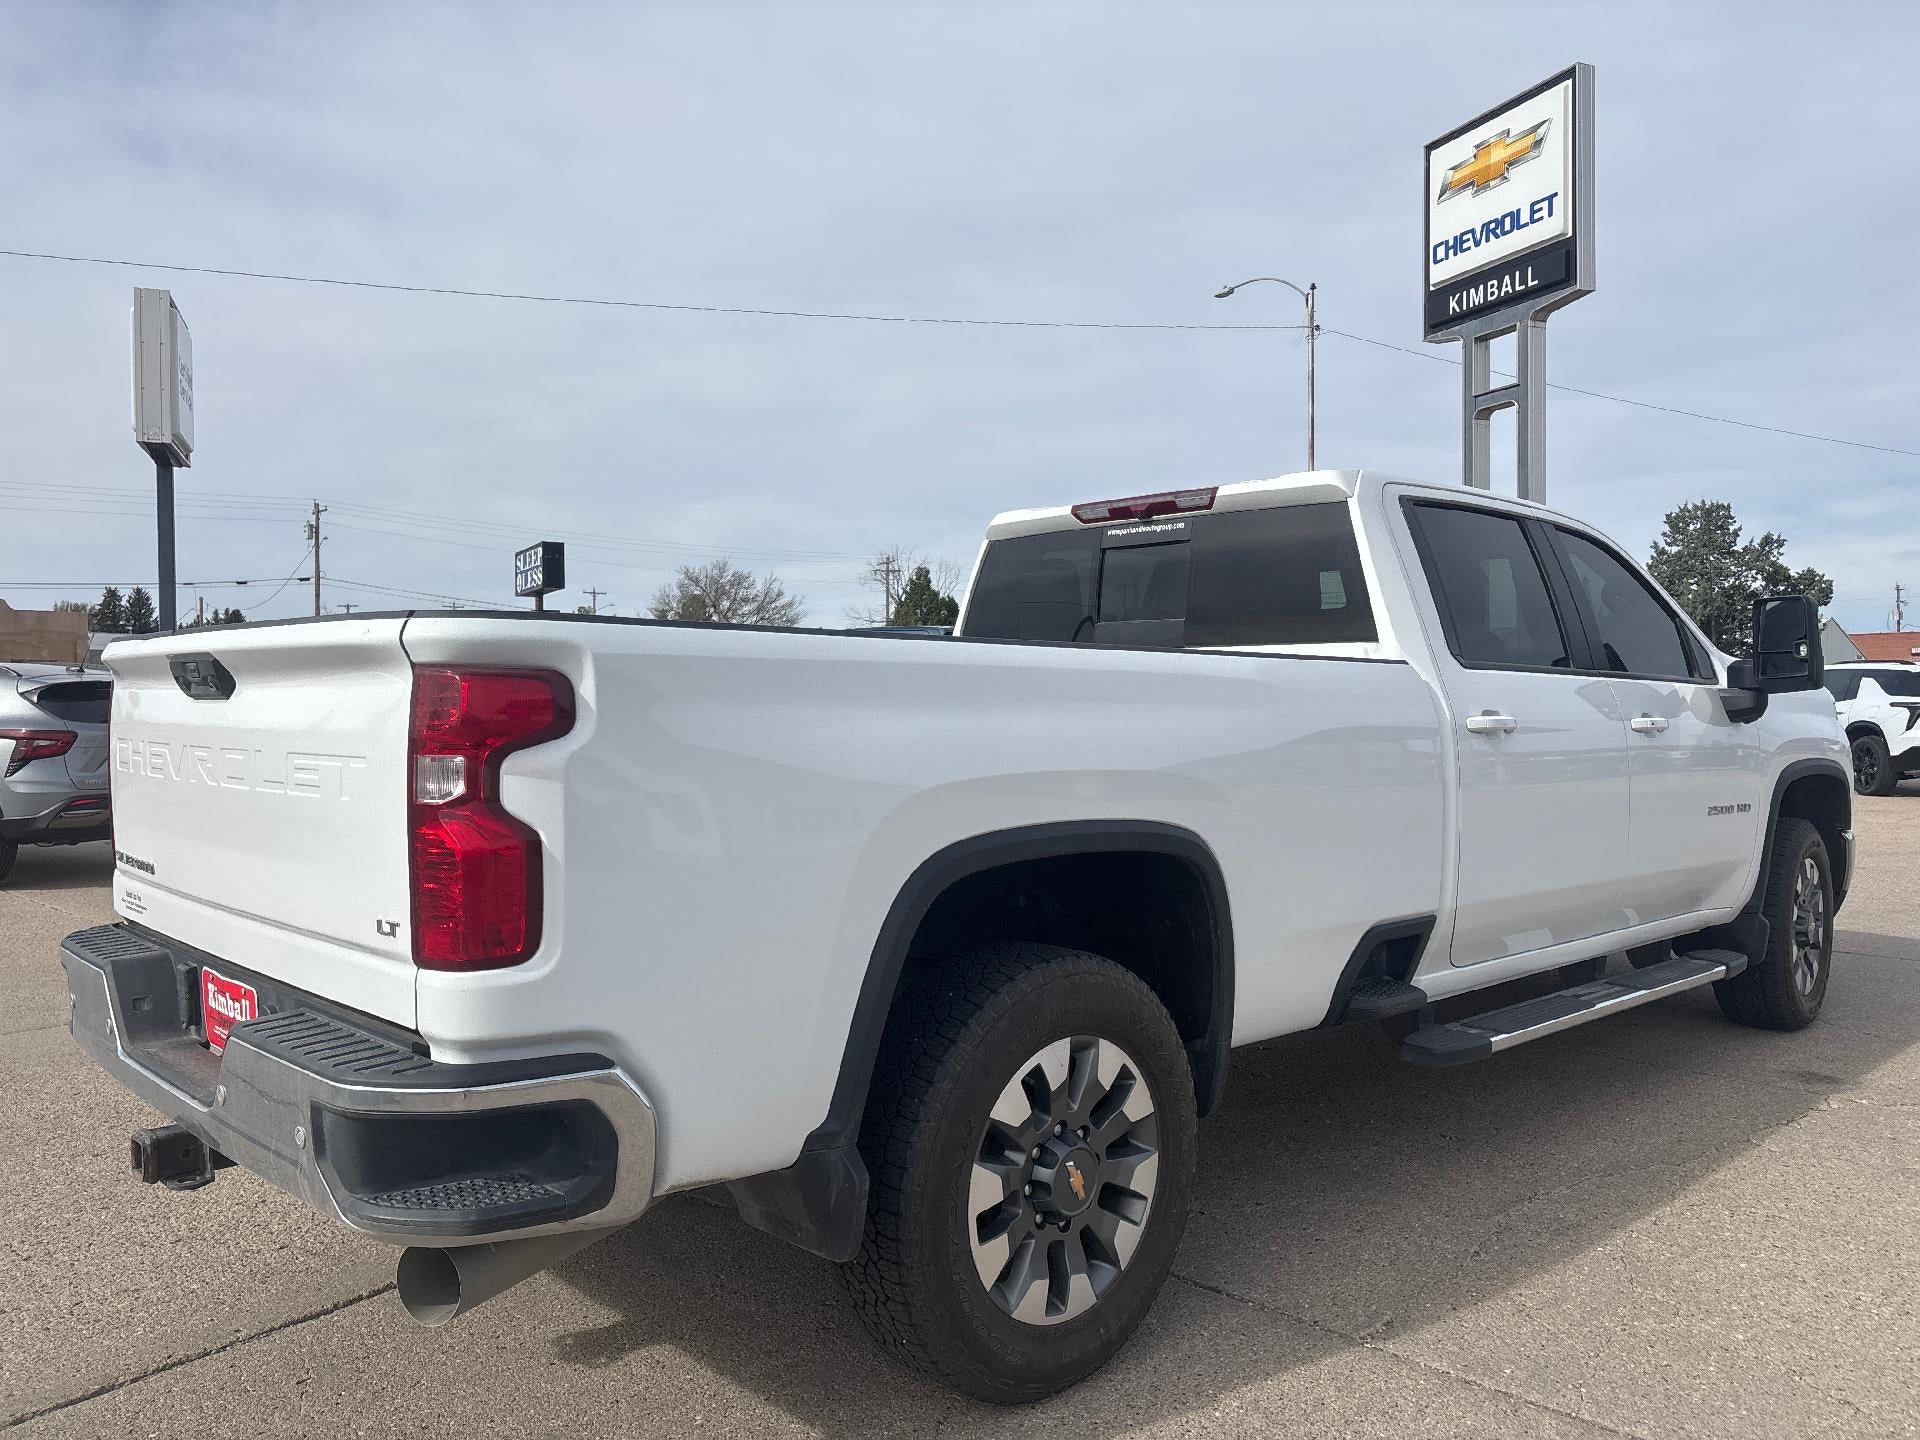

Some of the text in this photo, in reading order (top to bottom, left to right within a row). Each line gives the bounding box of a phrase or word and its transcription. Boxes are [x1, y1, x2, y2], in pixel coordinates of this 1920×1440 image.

[1432, 191, 1559, 265] CHEVROLET
[1448, 266, 1539, 315] KIMBALL
[516, 546, 542, 573] SLEEP
[114, 737, 367, 800] CHEVROLET
[1707, 804, 1734, 816] 2500
[376, 919, 400, 938] LT
[207, 981, 251, 1021] Kimball
